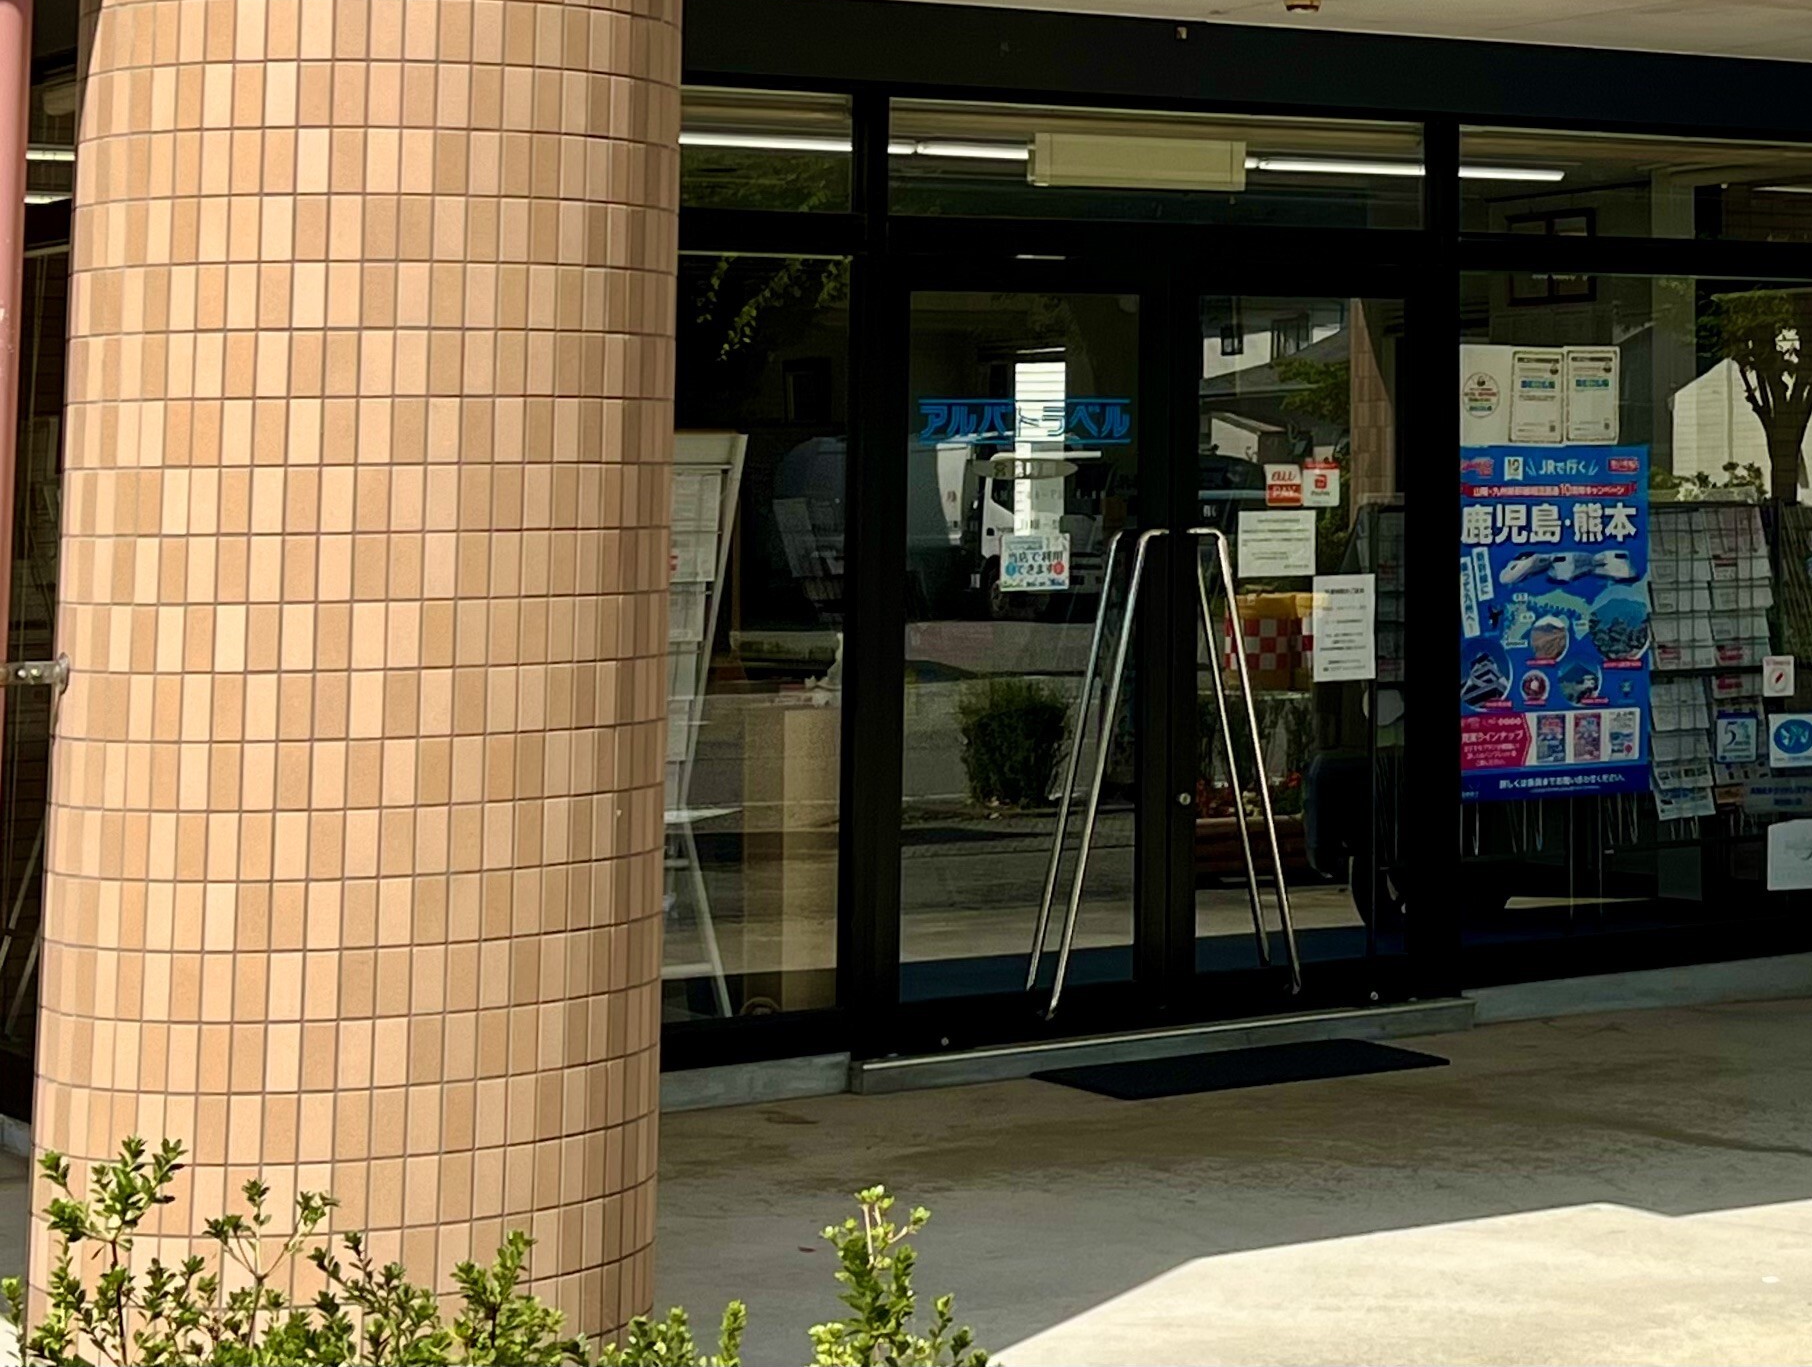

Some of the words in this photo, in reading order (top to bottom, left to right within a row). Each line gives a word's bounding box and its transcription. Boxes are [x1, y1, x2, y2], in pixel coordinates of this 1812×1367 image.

[918, 404, 1131, 440] アルバトラベル
[1539, 459, 1586, 476] JRで行く
[1461, 502, 1637, 544] 鹿児島・熊本
[1008, 550, 1063, 564] 当店で利用
